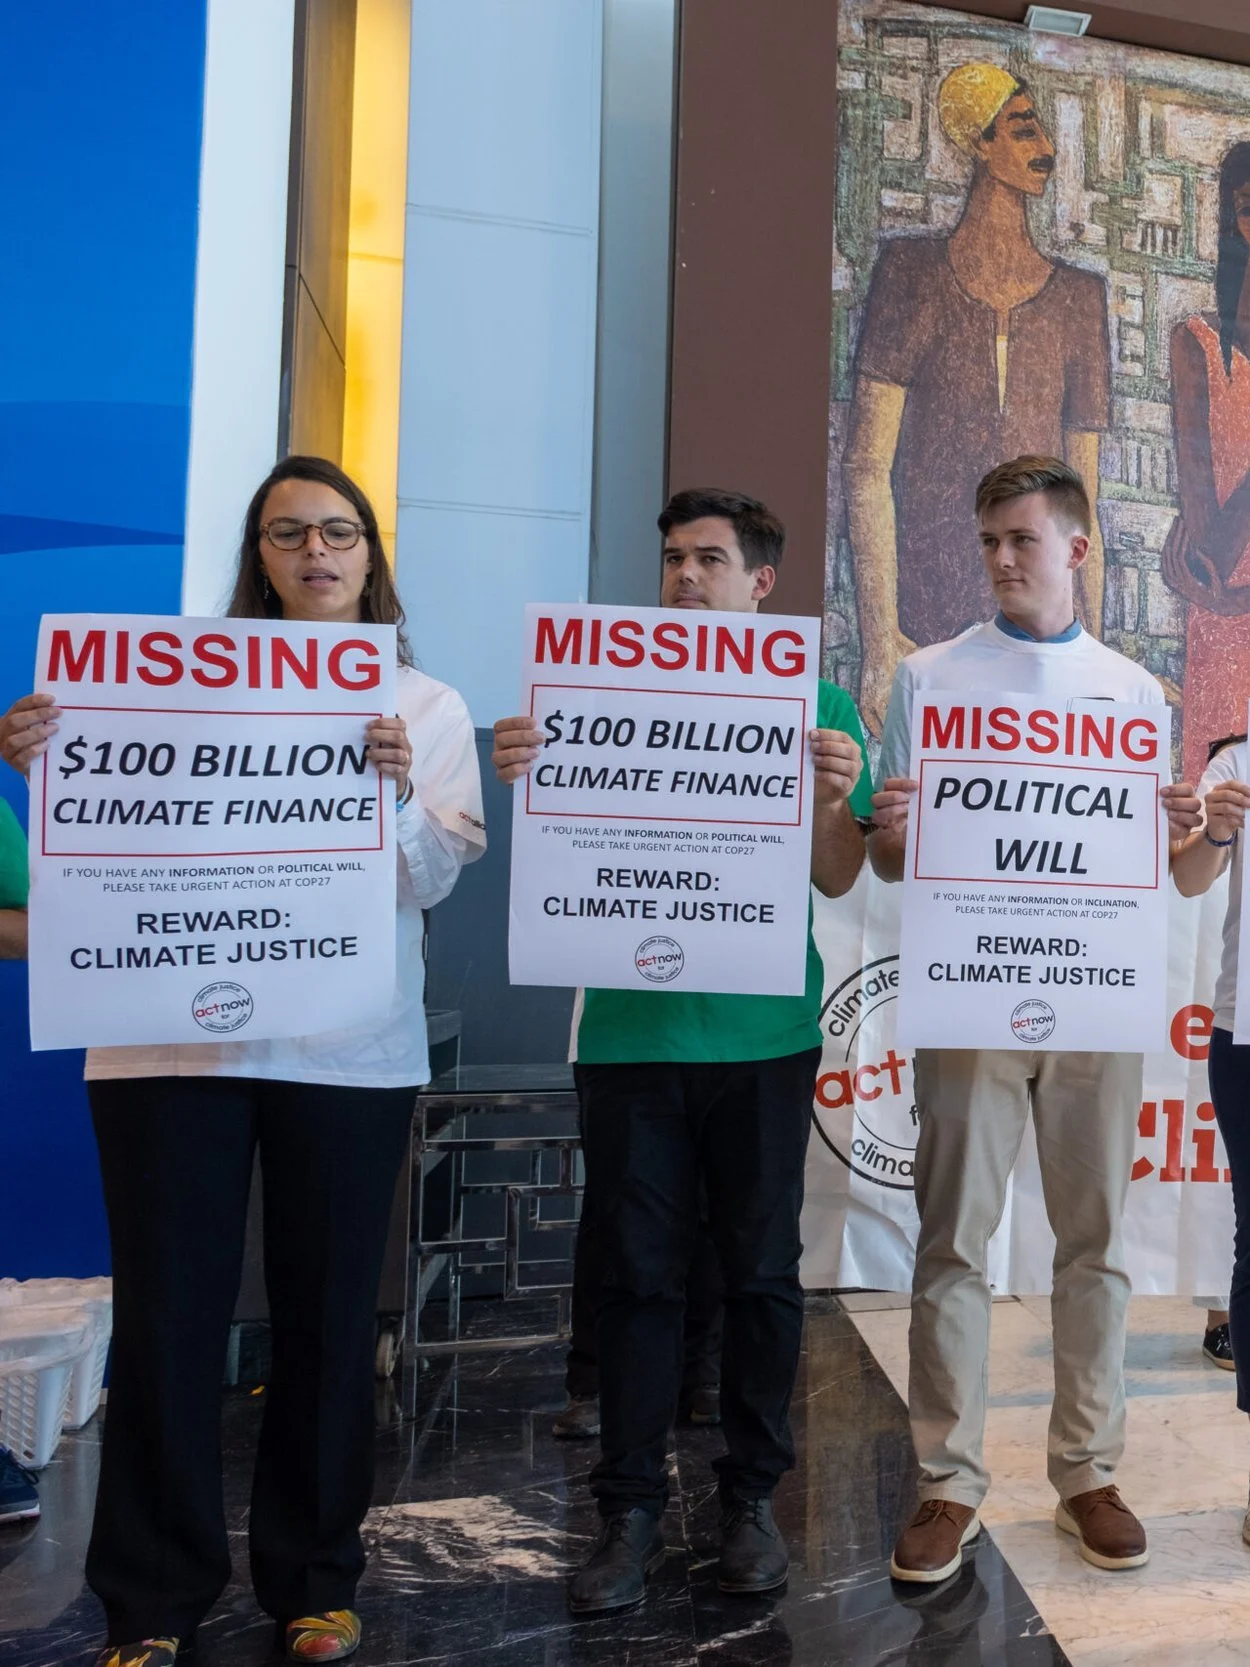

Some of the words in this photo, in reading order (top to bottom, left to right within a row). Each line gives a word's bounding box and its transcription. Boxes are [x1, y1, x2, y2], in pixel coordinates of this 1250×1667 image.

[47, 629, 380, 691] MISSING
[534, 617, 805, 677] MISSING
[543, 709, 635, 748] $100
[646, 719, 795, 755] BILLION
[921, 705, 1157, 762] MISSING
[58, 735, 176, 779] $100
[190, 743, 370, 777] BILLION
[535, 764, 663, 792] CLIMATE
[670, 771, 798, 799] FINANCE
[53, 797, 214, 825] CLIMATE
[224, 797, 377, 825] FINANCE
[933, 777, 1133, 819] POLITICAL
[542, 825, 550, 833] IF
[552, 826, 572, 835] YOU
[575, 827, 599, 836] HAVE
[602, 828, 622, 836] ANY
[624, 829, 692, 839] INFORMATION
[695, 832, 708, 840] OR
[711, 832, 758, 842] POLITICAL
[572, 839, 606, 849] PLEASE
[607, 841, 630, 850] TAKE
[633, 842, 672, 851] URGENT
[673, 844, 708, 853] ACTION
[711, 845, 722, 854] AT
[724, 845, 755, 855] COP27
[63, 868, 73, 877] IF
[76, 868, 102, 877] YOU
[105, 868, 137, 877] HAVE
[140, 868, 165, 877] ANY
[169, 866, 254, 877] INFORMATION
[258, 865, 274, 874] OR
[277, 863, 334, 873] POLITICAL
[995, 838, 1087, 874] WILL
[103, 882, 145, 892] PLEASE
[148, 882, 177, 892] TAKE
[181, 881, 229, 891] URGENT
[232, 879, 275, 889] ACTION
[278, 878, 292, 887] AT
[295, 876, 330, 887] COP27
[597, 867, 719, 891] REWARD:
[543, 896, 657, 919] CLIMATE
[665, 901, 774, 923] JUSTICE
[933, 892, 941, 900] IF
[942, 892, 961, 901] YOU
[963, 893, 985, 902] HAVE
[987, 894, 1006, 902] ANY
[1007, 895, 1068, 905] INFORMATION
[1070, 897, 1082, 905] OR
[955, 905, 985, 914] PLEASE
[986, 906, 1008, 915] TAKE
[1010, 907, 1045, 916] URGENT
[1046, 908, 1078, 917] ACTION
[1079, 910, 1090, 918] AT
[1091, 910, 1118, 919] COP27
[137, 908, 290, 934] REWARD:
[70, 943, 216, 969] CLIMATE
[227, 936, 357, 963] JUSTICE
[977, 935, 1086, 957] REWARD:
[928, 962, 1031, 983] CLIMATE
[1038, 966, 1135, 986] JUSTICE
[828, 970, 899, 1036] climate
[816, 1050, 906, 1109] act
[851, 1139, 914, 1176] clima
